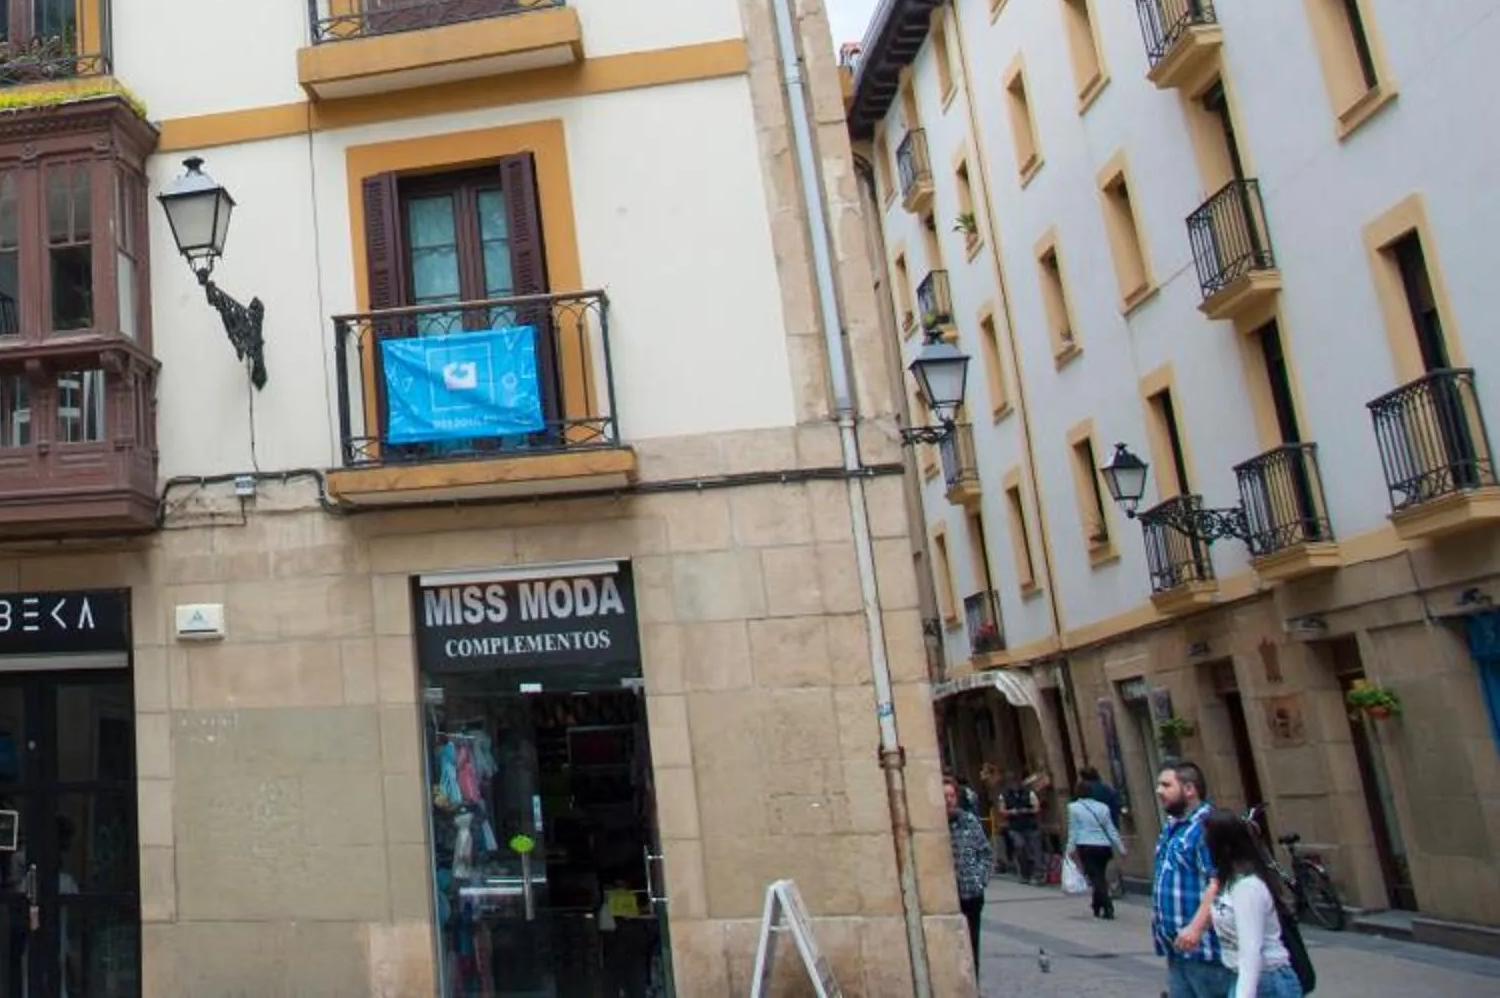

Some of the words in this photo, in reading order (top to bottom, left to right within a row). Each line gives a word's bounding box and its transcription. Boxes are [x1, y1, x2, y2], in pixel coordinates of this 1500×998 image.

[423, 584, 508, 626] MISS
[518, 577, 624, 620] MODA
[445, 629, 611, 657] COMPLEMENTOS
